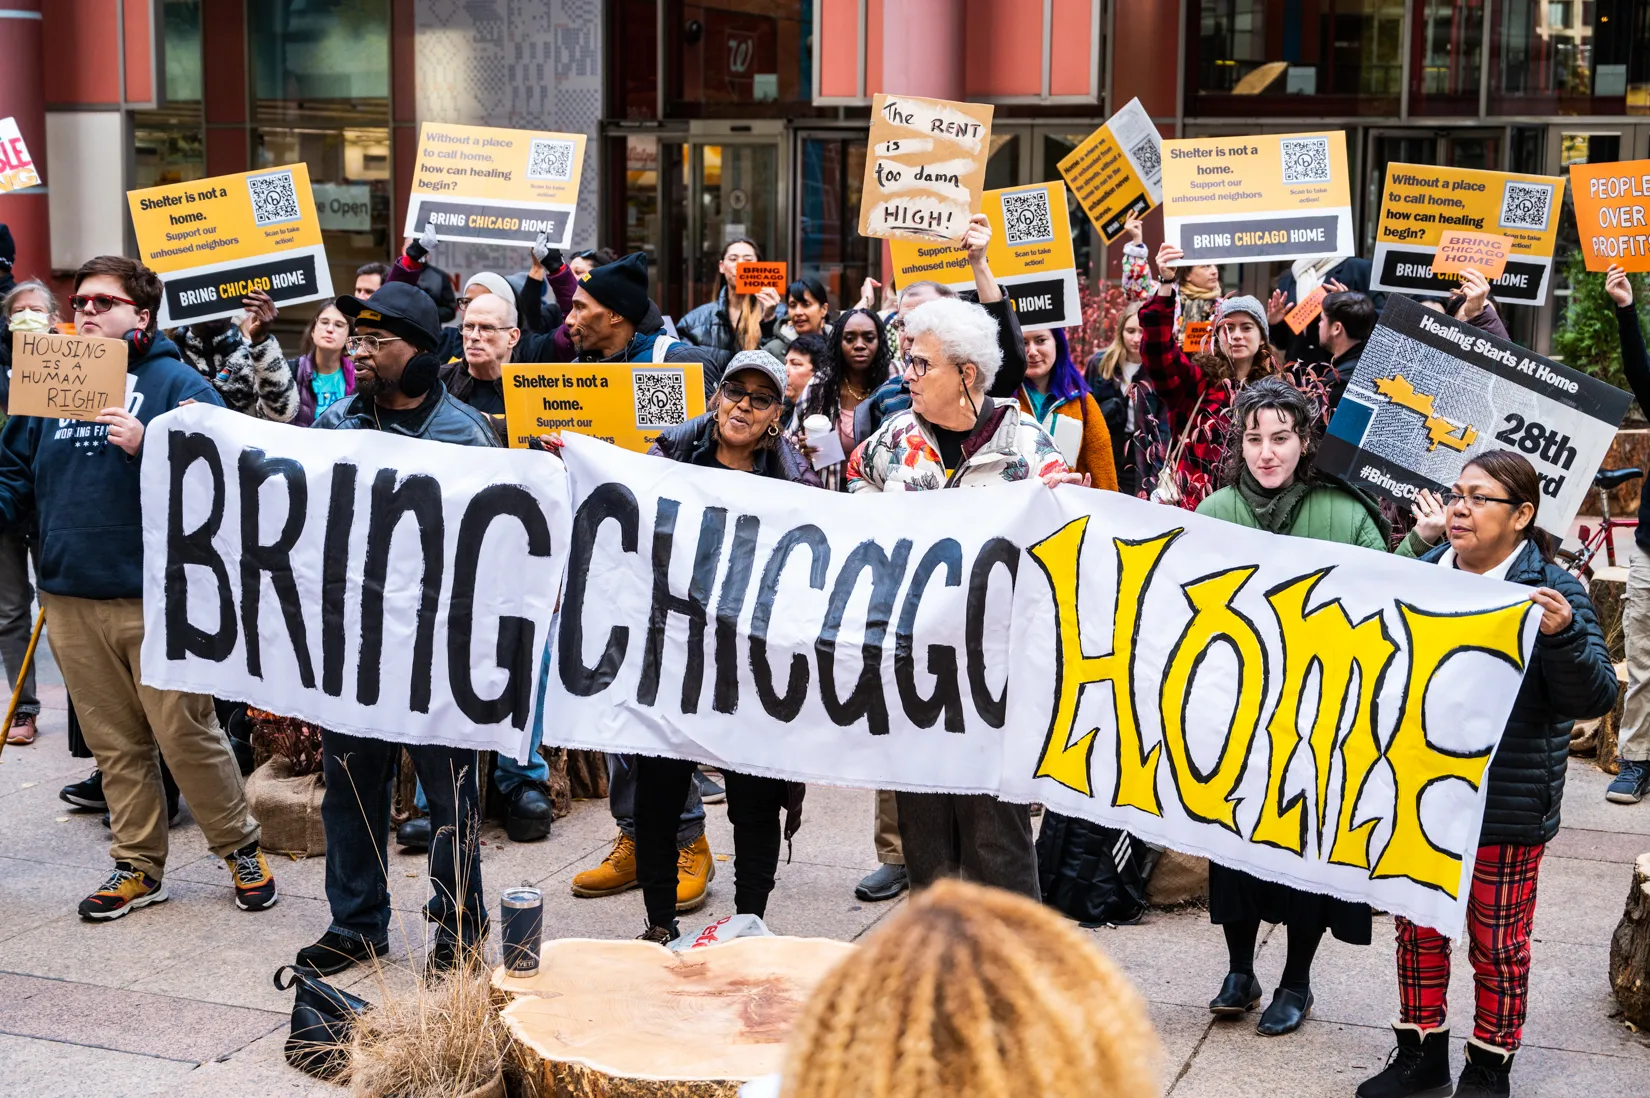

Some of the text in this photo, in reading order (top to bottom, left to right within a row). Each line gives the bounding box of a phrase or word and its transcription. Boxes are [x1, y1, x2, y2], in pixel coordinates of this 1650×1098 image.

[883, 102, 981, 138] The RENT
[426, 132, 513, 149] Without a place
[887, 140, 900, 152] is
[423, 149, 494, 163] to call home,
[1170, 145, 1259, 159] Shelter is not a
[421, 163, 512, 181] how can healing
[876, 162, 960, 188] too damn
[1197, 165, 1234, 176] home.
[418, 179, 458, 192] begin?
[1190, 180, 1226, 190] Support
[1392, 174, 1486, 193] Without a place
[1590, 175, 1650, 199] PEOPLE
[140, 188, 228, 211] Shelter is not a
[1172, 191, 1263, 203] unhoused neighbors
[1299, 196, 1320, 204] action!
[1389, 192, 1466, 209] to call home,
[330, 198, 369, 218] Open
[169, 210, 207, 226] home.
[429, 212, 555, 233] BRING CHICAGO HOME
[884, 205, 952, 230] HIGH!
[1386, 209, 1485, 230] how can healing
[1599, 206, 1647, 229] OVER
[166, 226, 217, 242] Support our
[264, 230, 279, 238] Scan
[287, 226, 300, 234] take
[1194, 228, 1325, 249] BRING CHICAGO HOME
[1383, 226, 1426, 241] begin?
[150, 236, 240, 259] unhoused neighbors
[274, 237, 295, 246] action!
[1449, 237, 1502, 250] BRING
[918, 246, 952, 257] Support
[1038, 248, 1052, 256] take
[1442, 246, 1505, 259] CHICAGO
[902, 261, 944, 274] unhoused
[1024, 258, 1045, 267] action!
[1445, 254, 1495, 267] HOME
[1396, 263, 1434, 279] BRING
[179, 270, 306, 307] BRING CHICAGO HOME
[1018, 294, 1053, 313] HOME
[22, 335, 107, 359] HOUSING
[1420, 314, 1580, 394] Healing Starts At Home
[42, 360, 82, 371] IS A
[21, 370, 88, 386] HUMAN
[513, 375, 609, 388] Shelter is not a
[47, 388, 109, 409] RIGHT!
[543, 398, 584, 411] home.
[536, 417, 593, 430] Support our
[54, 427, 91, 440] WORING
[1495, 413, 1577, 471] 28th
